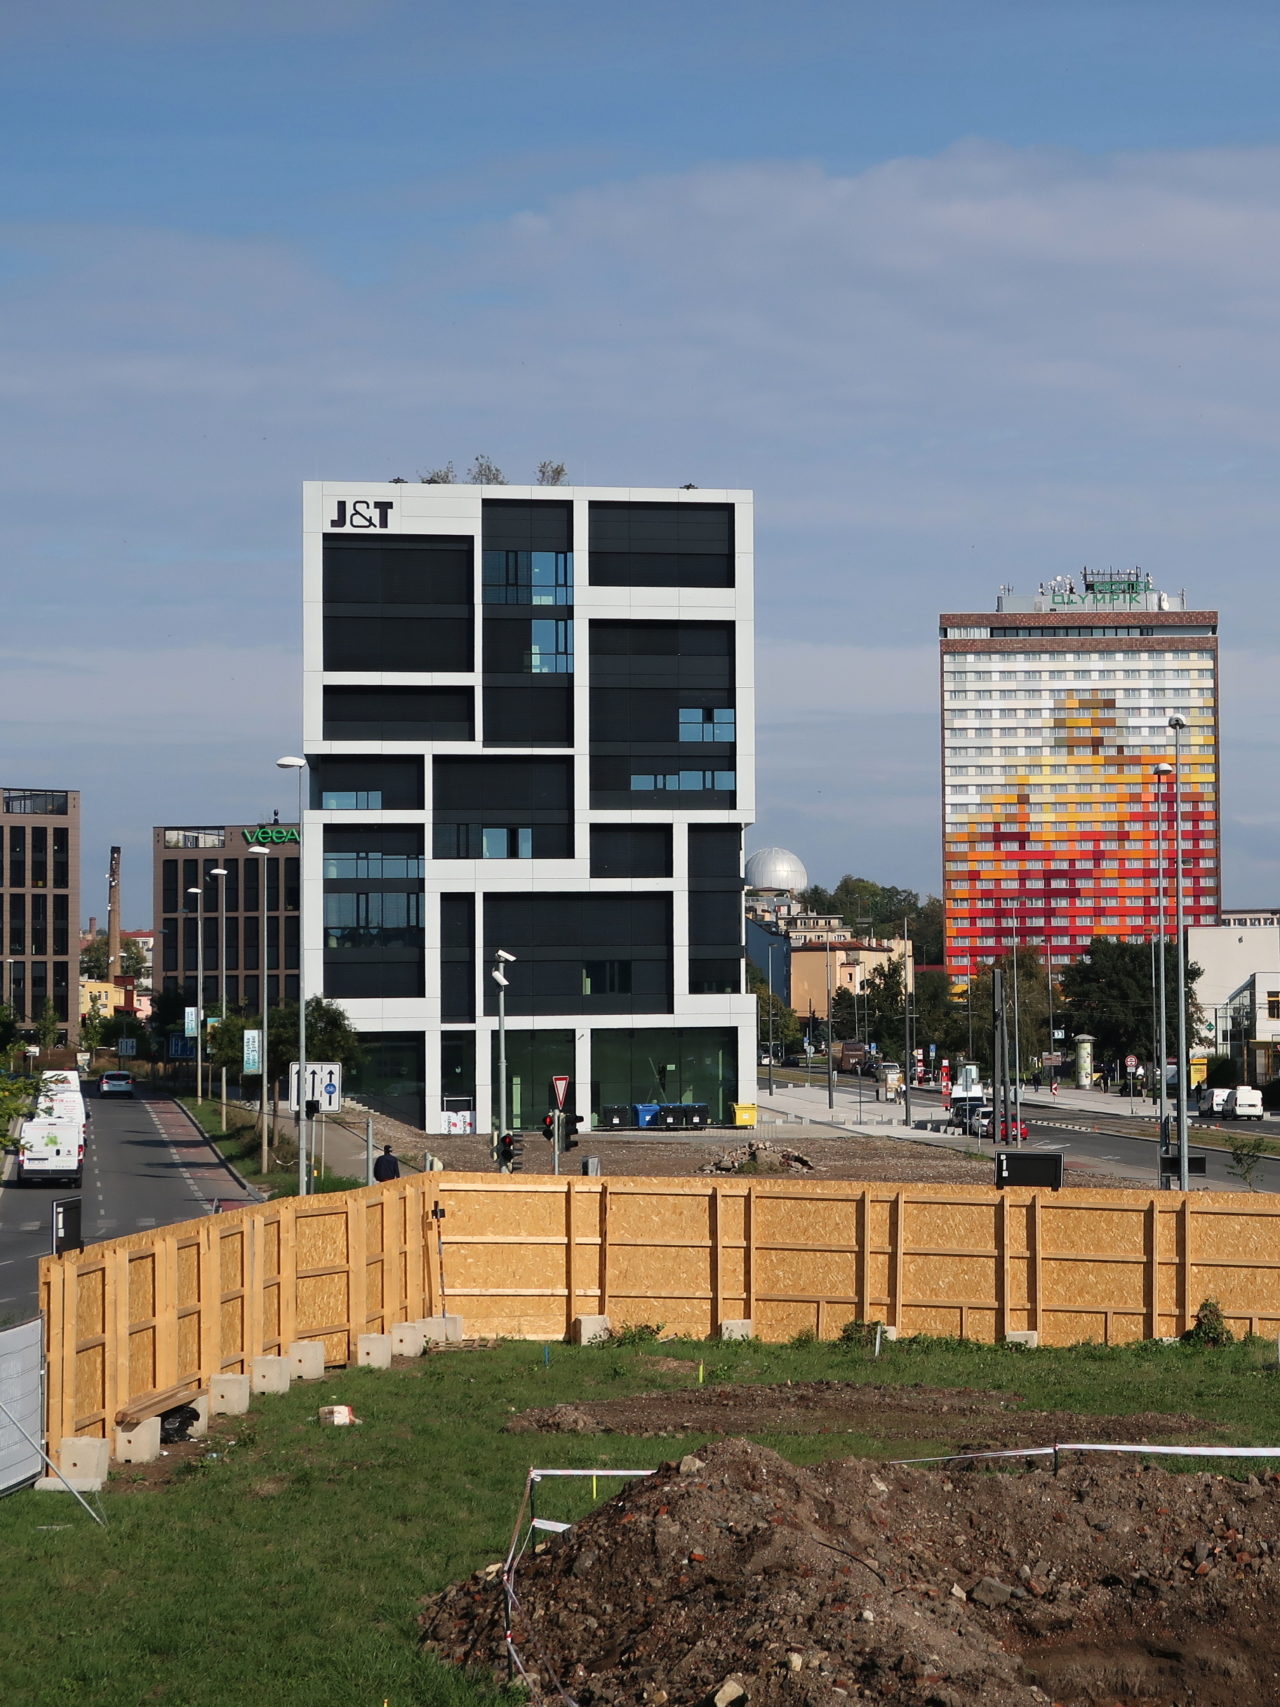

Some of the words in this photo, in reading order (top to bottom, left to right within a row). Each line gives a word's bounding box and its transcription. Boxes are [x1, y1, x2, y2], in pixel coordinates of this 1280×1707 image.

[330, 500, 393, 528] J&T
[1052, 593, 1141, 605] OLYMPIK
[243, 828, 300, 843] VeeA
